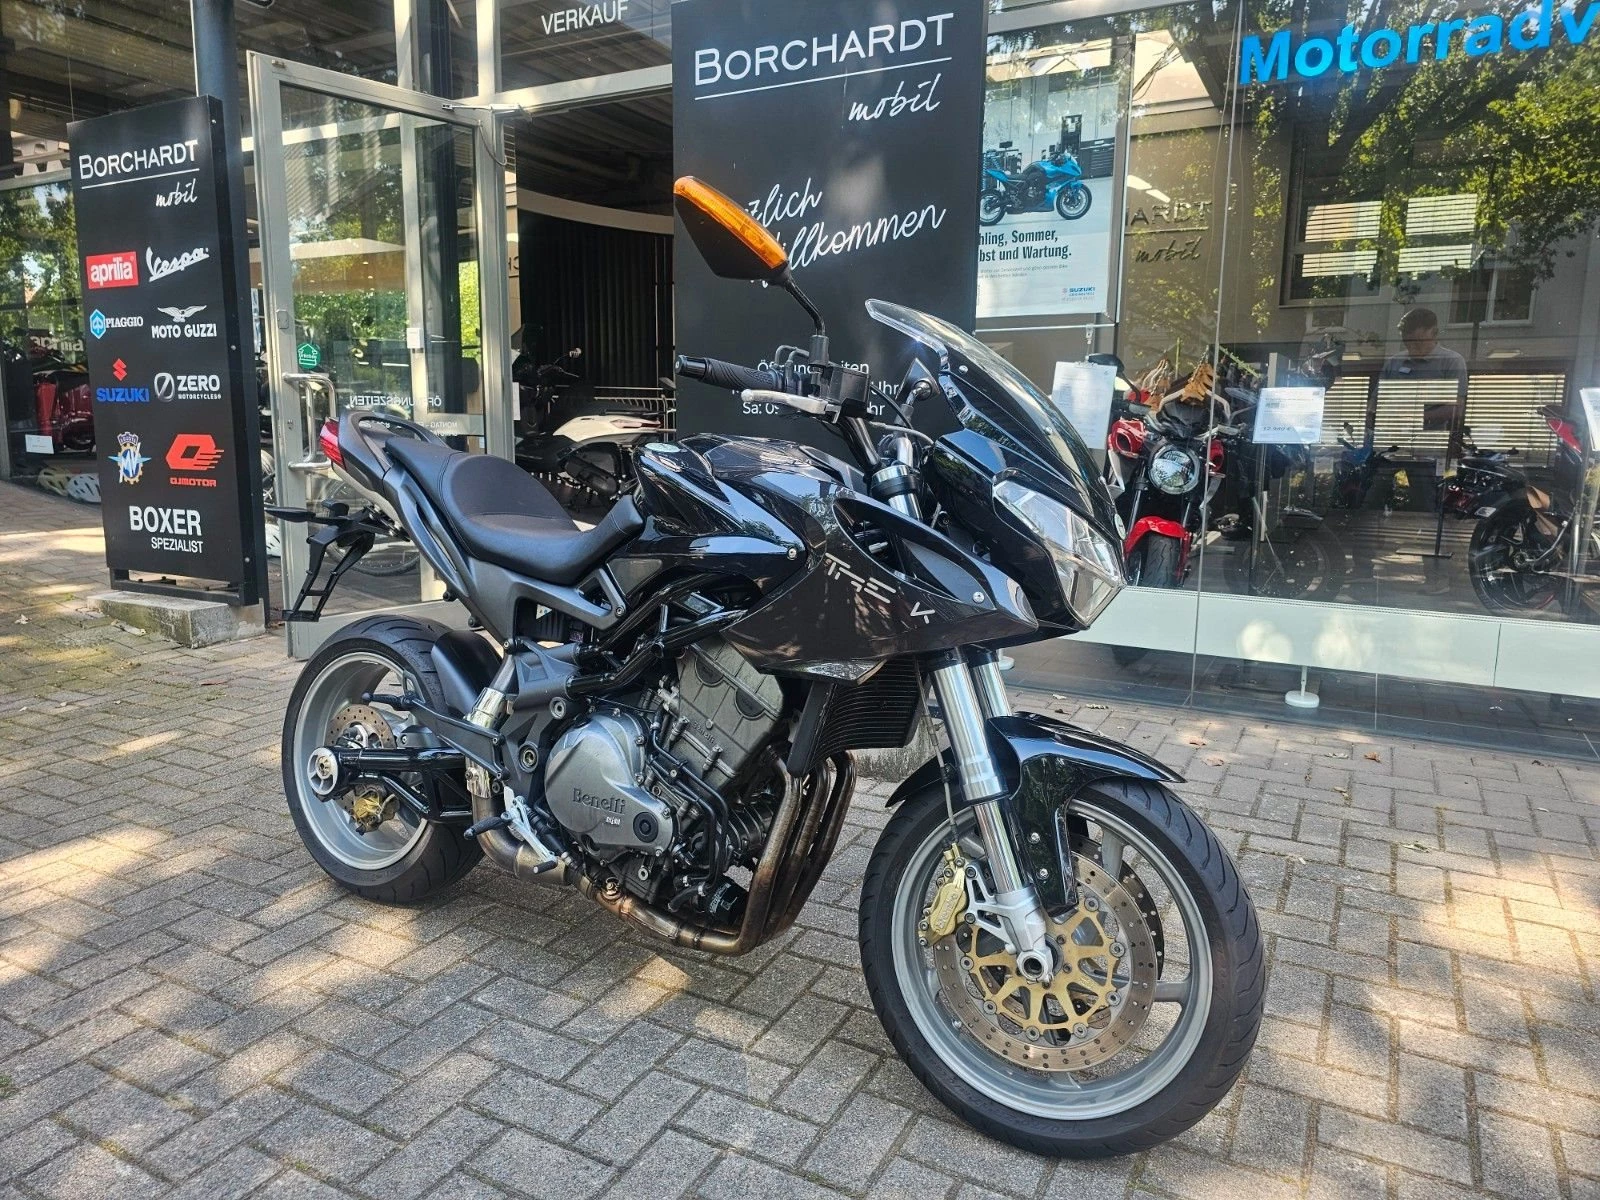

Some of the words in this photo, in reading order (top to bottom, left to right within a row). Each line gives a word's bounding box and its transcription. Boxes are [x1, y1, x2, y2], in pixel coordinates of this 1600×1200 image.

[541, 1, 630, 36] VERKAUF
[694, 13, 954, 86] BORCHARDT
[848, 73, 941, 121] mobil
[78, 139, 199, 180] BORCHARDT
[155, 178, 198, 207] mobil
[1012, 230, 1058, 243] Sommer,
[90, 257, 134, 287] aprilia
[145, 246, 210, 283] Vespa
[999, 247, 1019, 261] und
[1022, 245, 1072, 260] Wartung.
[105, 316, 144, 329] PIAGGIO
[151, 324, 181, 339] MOTO
[184, 323, 218, 338] GUZZI
[96, 387, 150, 403] SUZUKI
[176, 374, 221, 392] ZERO
[129, 505, 203, 536] BOXER
[151, 537, 204, 553] SPEZIALIST
[573, 787, 627, 816] Benelli
